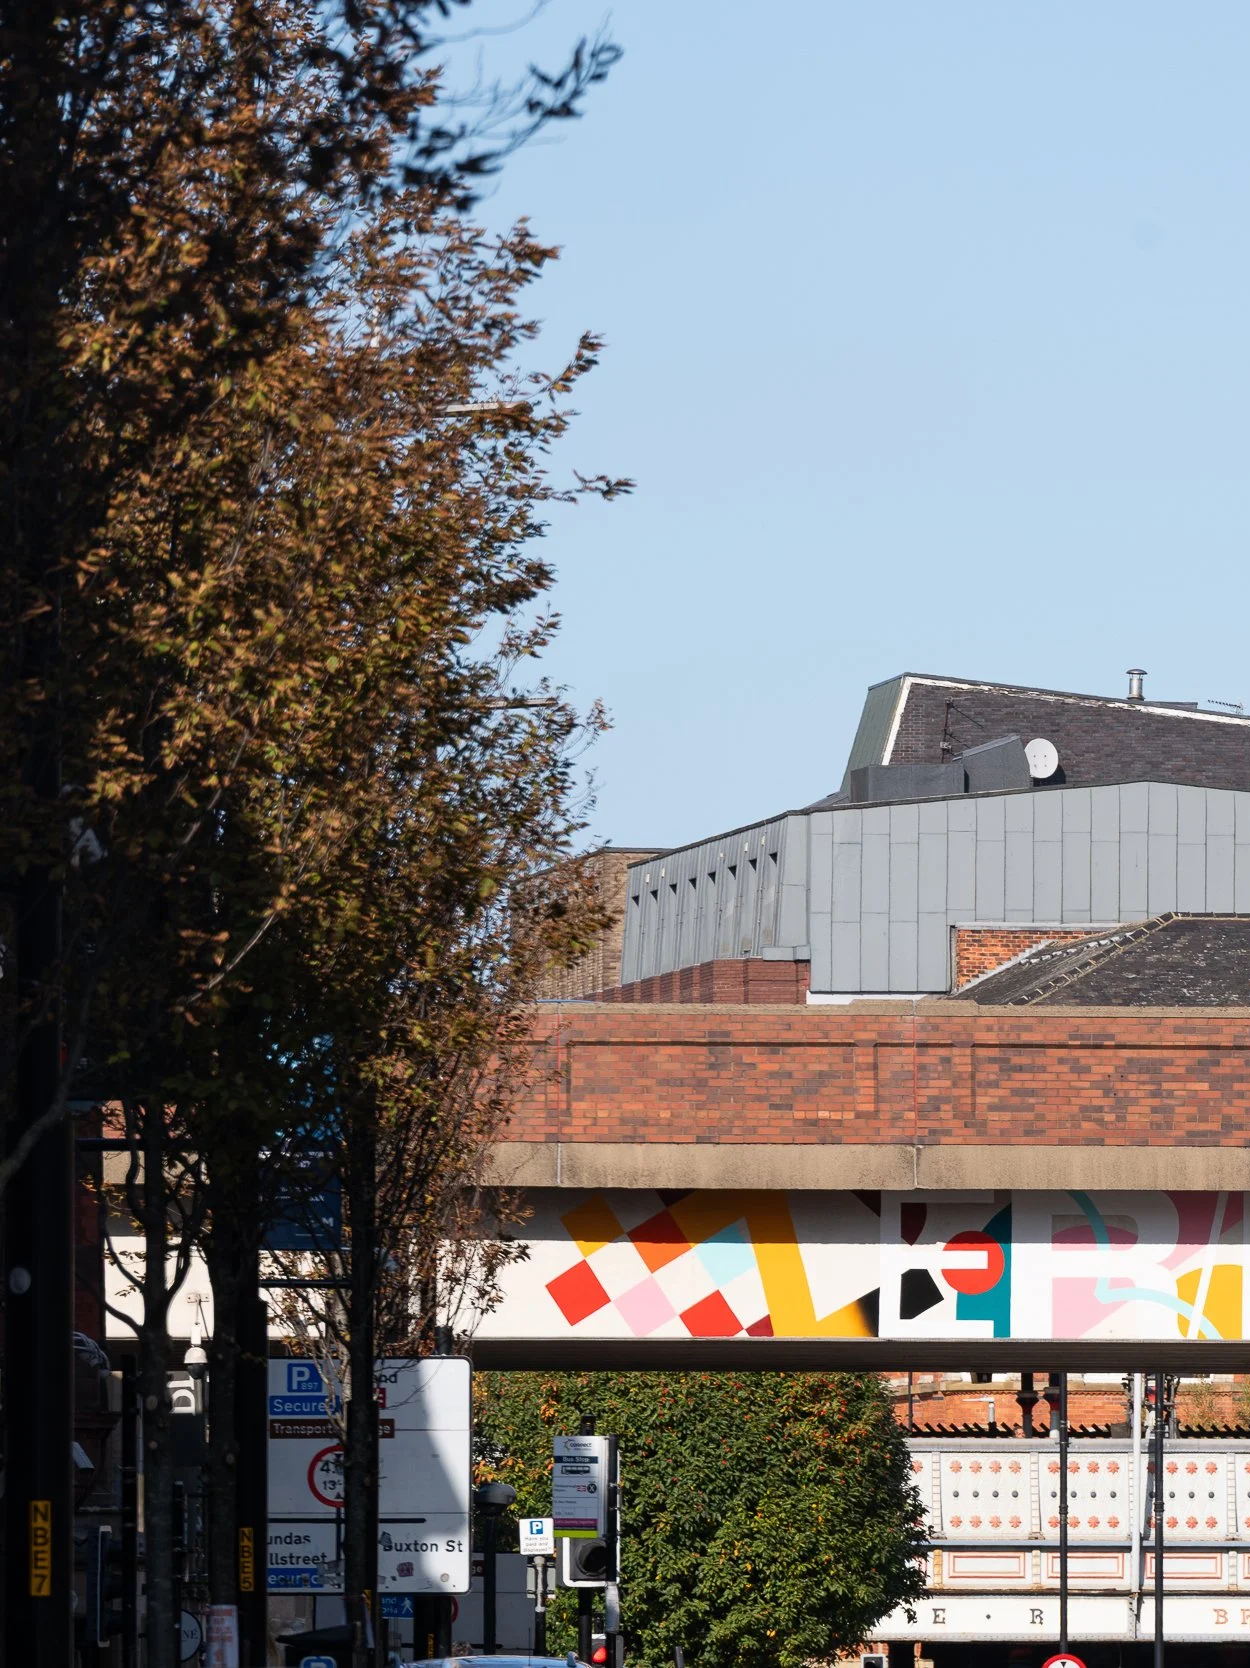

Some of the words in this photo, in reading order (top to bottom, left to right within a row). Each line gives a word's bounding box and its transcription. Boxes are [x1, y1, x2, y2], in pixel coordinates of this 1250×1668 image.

[273, 1399, 336, 1412] Secured
[273, 1423, 336, 1436] Transport
[267, 1532, 311, 1545] undas
[33, 1503, 49, 1595] NBE7
[383, 1539, 438, 1552] Buxton
[445, 1539, 463, 1552] St
[241, 1530, 252, 1590] NBE5
[269, 1552, 327, 1565] llstreet
